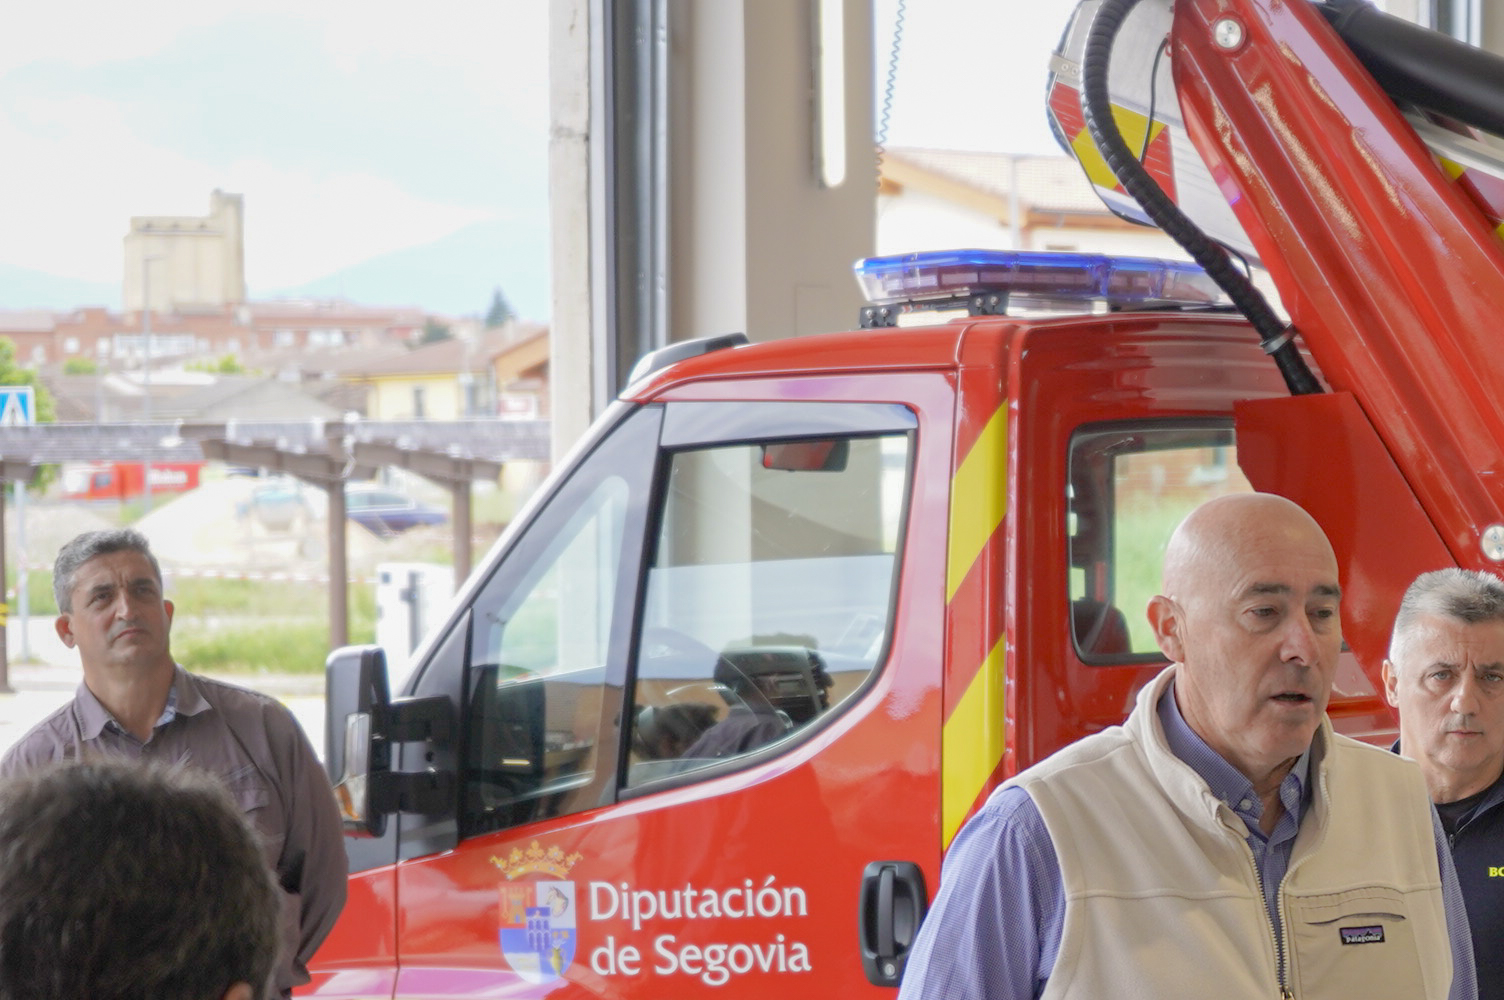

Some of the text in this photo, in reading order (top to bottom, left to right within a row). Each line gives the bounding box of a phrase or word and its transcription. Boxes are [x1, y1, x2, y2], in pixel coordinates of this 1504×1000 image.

[590, 875, 808, 930] Diputación
[591, 934, 812, 986] de Segovia
